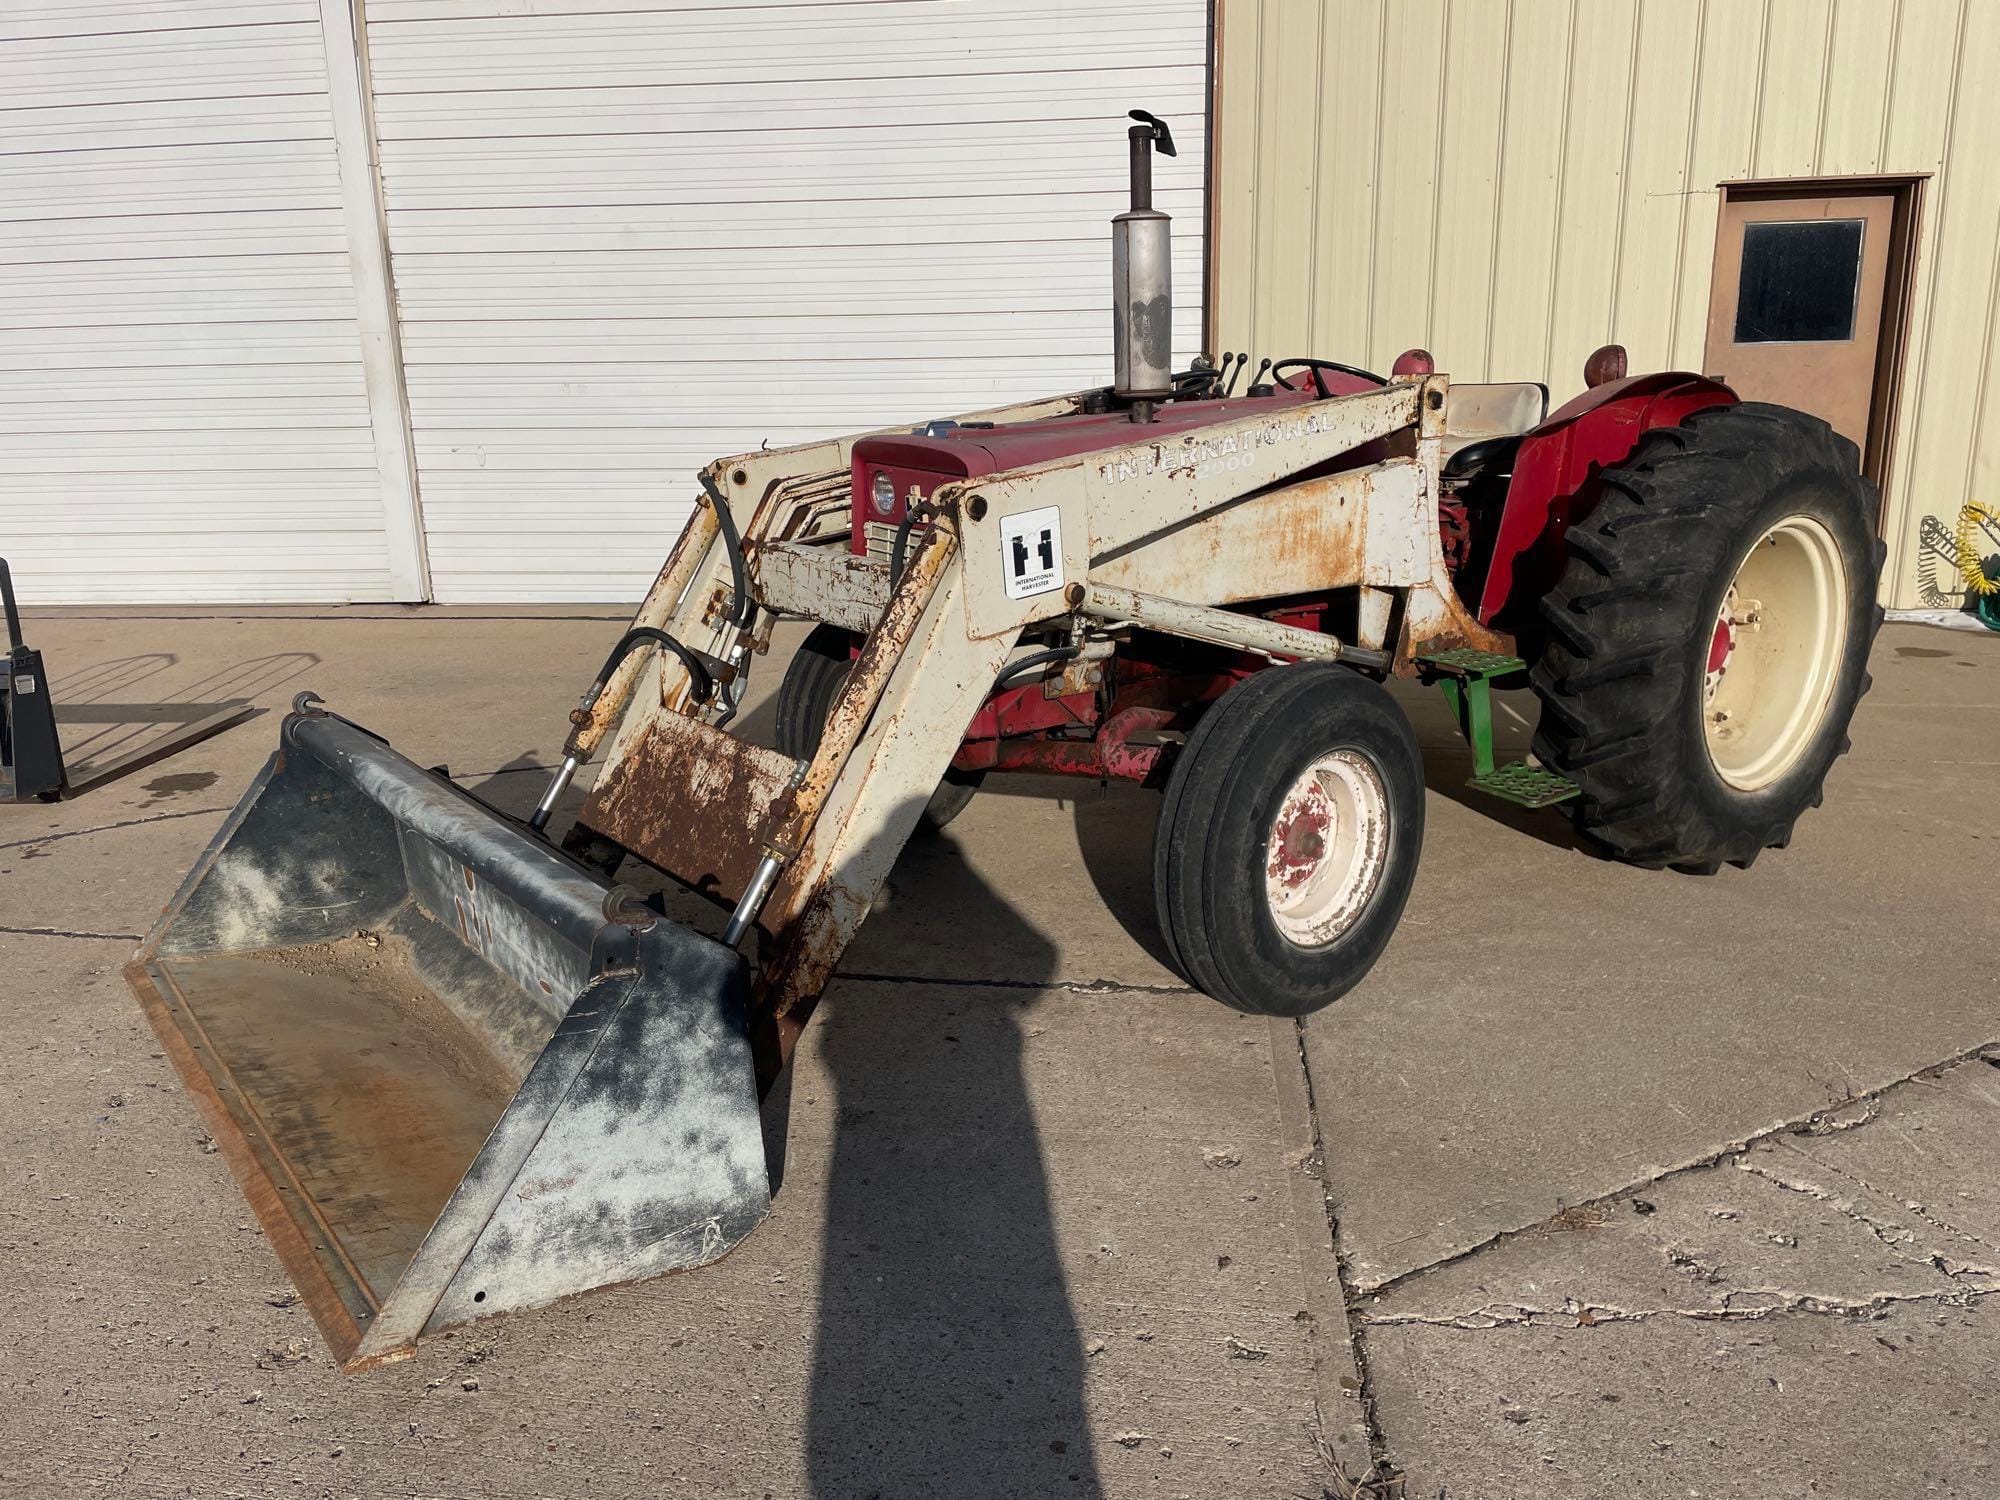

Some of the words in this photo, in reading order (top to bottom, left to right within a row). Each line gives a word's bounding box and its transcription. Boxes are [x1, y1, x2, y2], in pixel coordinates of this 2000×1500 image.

[1104, 412, 1337, 486] INTERNATIONAL
[1196, 452, 1256, 480] 2000
[1015, 572, 1055, 587] INTERNATIONAL
[1021, 579, 1050, 591] HARVESTER
